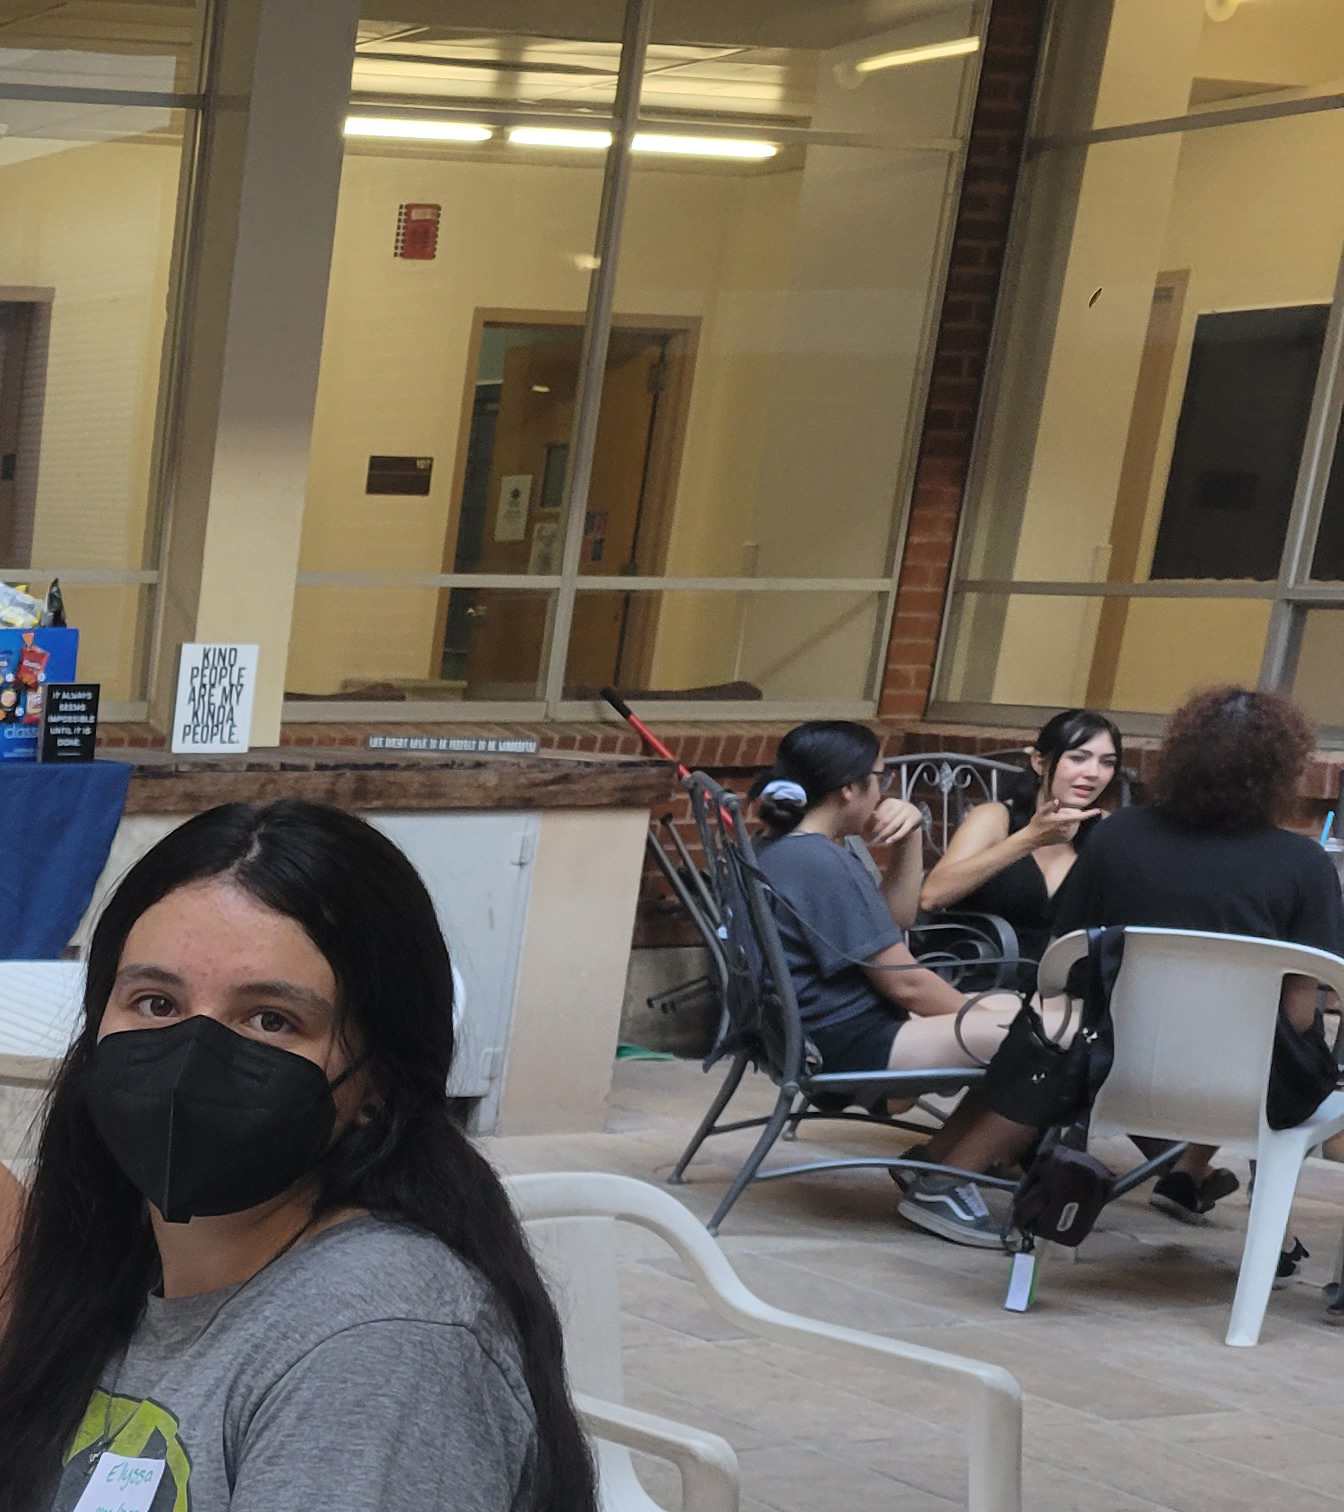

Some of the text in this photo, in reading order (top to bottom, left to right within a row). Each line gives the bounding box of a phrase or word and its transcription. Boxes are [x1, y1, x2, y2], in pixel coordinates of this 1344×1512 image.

[202, 647, 238, 668] KIND
[190, 665, 247, 687] PEOPLE
[61, 690, 92, 700] ALWAYS
[186, 683, 244, 706] ARE MY
[48, 714, 95, 723] IMPOSSIBLE
[191, 703, 236, 726] KINDA
[181, 724, 240, 744] PEOPLE.
[105, 1461, 154, 1491] Elyssa
